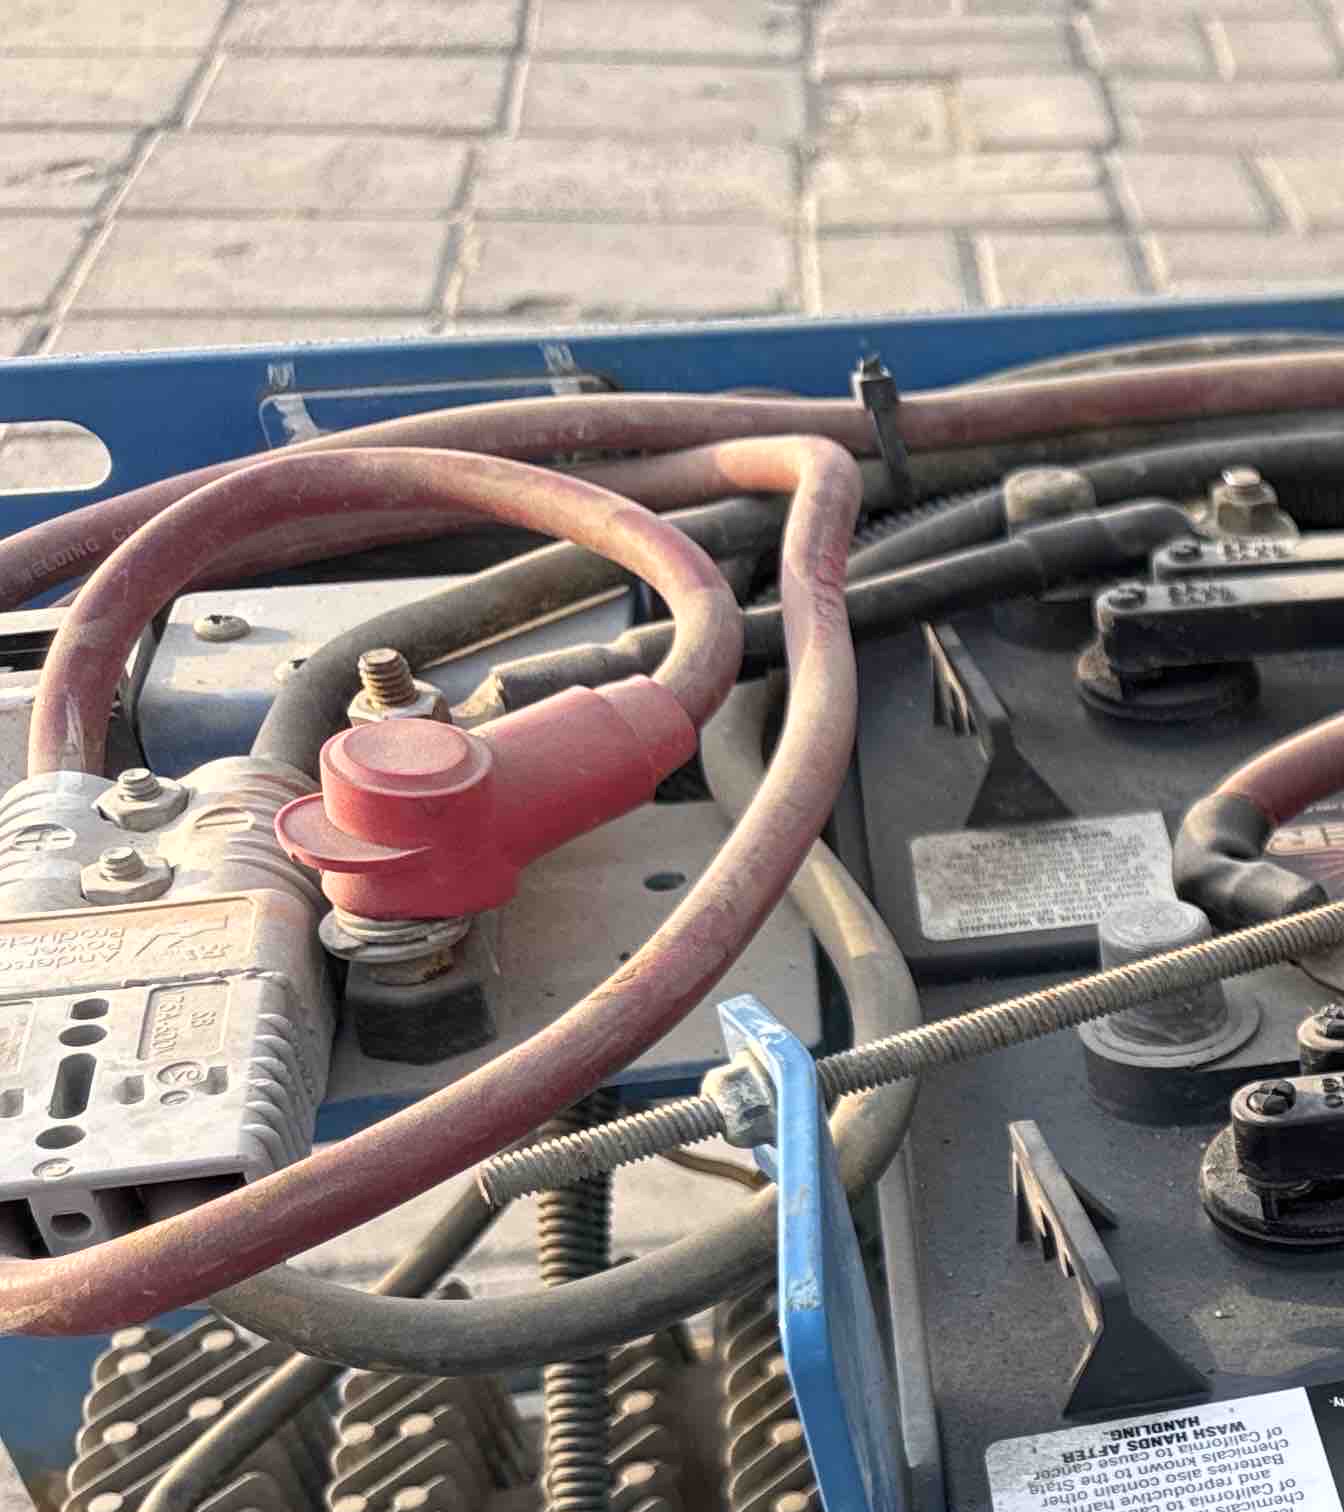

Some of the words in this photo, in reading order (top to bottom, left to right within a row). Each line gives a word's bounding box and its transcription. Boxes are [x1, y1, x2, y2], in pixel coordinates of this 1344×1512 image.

[1101, 1413, 1201, 1443] HANDLING.
[1191, 1419, 1245, 1440] WASH
[1263, 1424, 1283, 1440] of
[1124, 1429, 1188, 1452] HANDS
[1175, 1428, 1261, 1457] California
[1199, 1436, 1289, 1465] chemicals
[1060, 1441, 1122, 1465] AFTER
[1095, 1449, 1150, 1470] cause
[1153, 1445, 1173, 1460] to
[1111, 1466, 1132, 1482] to
[1135, 1454, 1197, 1478] known
[1205, 1451, 1284, 1478] Batteries
[1028, 1477, 1076, 1497] State
[1079, 1471, 1109, 1488] the
[1091, 1474, 1161, 1499] contain
[1163, 1467, 1203, 1486] also
[1236, 1467, 1271, 1486] and
[1277, 1476, 1296, 1493] of
[1040, 1488, 1089, 1509] other
[1117, 1470, 1233, 1508] reproductive
[1186, 1481, 1274, 1510] California
